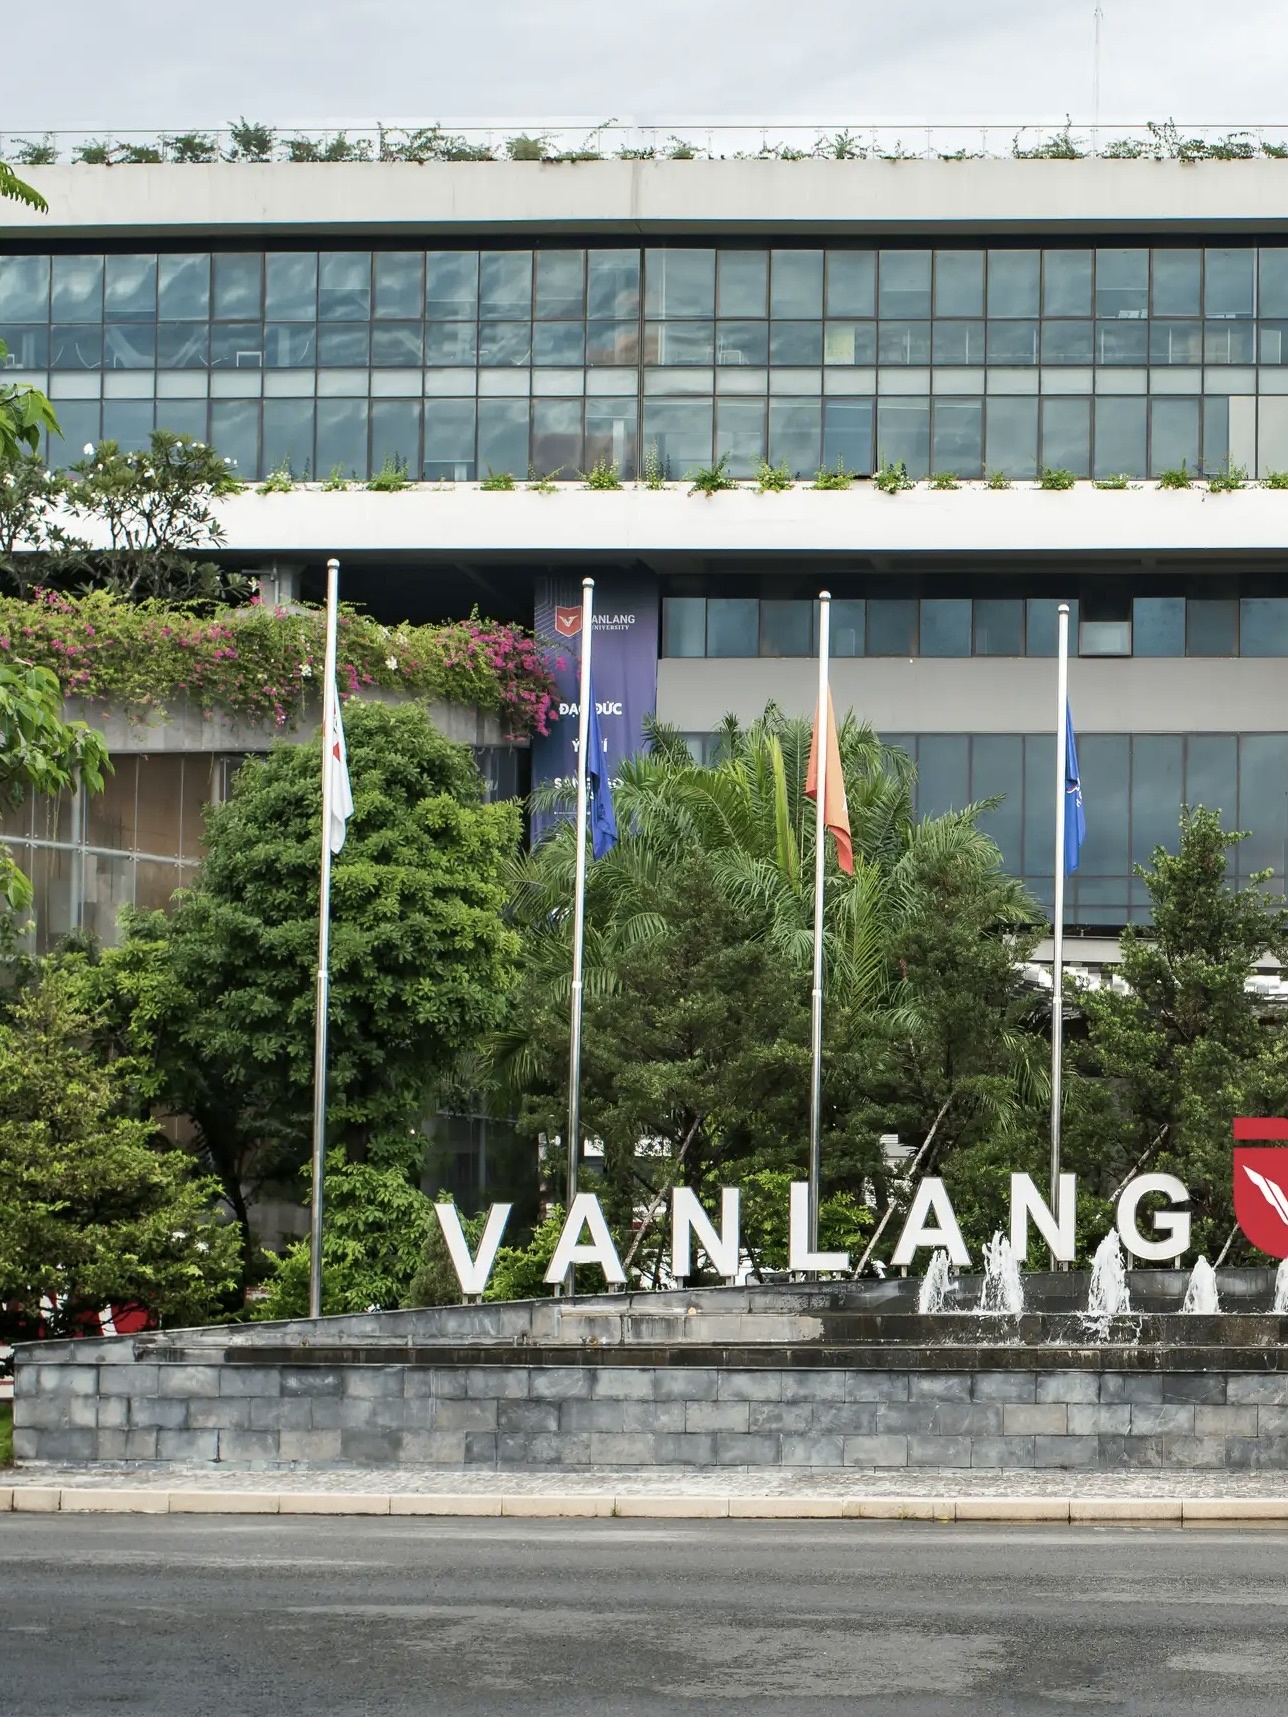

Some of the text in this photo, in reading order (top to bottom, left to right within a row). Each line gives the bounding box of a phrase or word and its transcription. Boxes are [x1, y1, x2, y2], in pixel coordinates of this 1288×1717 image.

[591, 614, 636, 624] ANLANG
[558, 702, 581, 718] ĐẠ
[434, 1172, 1192, 1296] VANLANG
